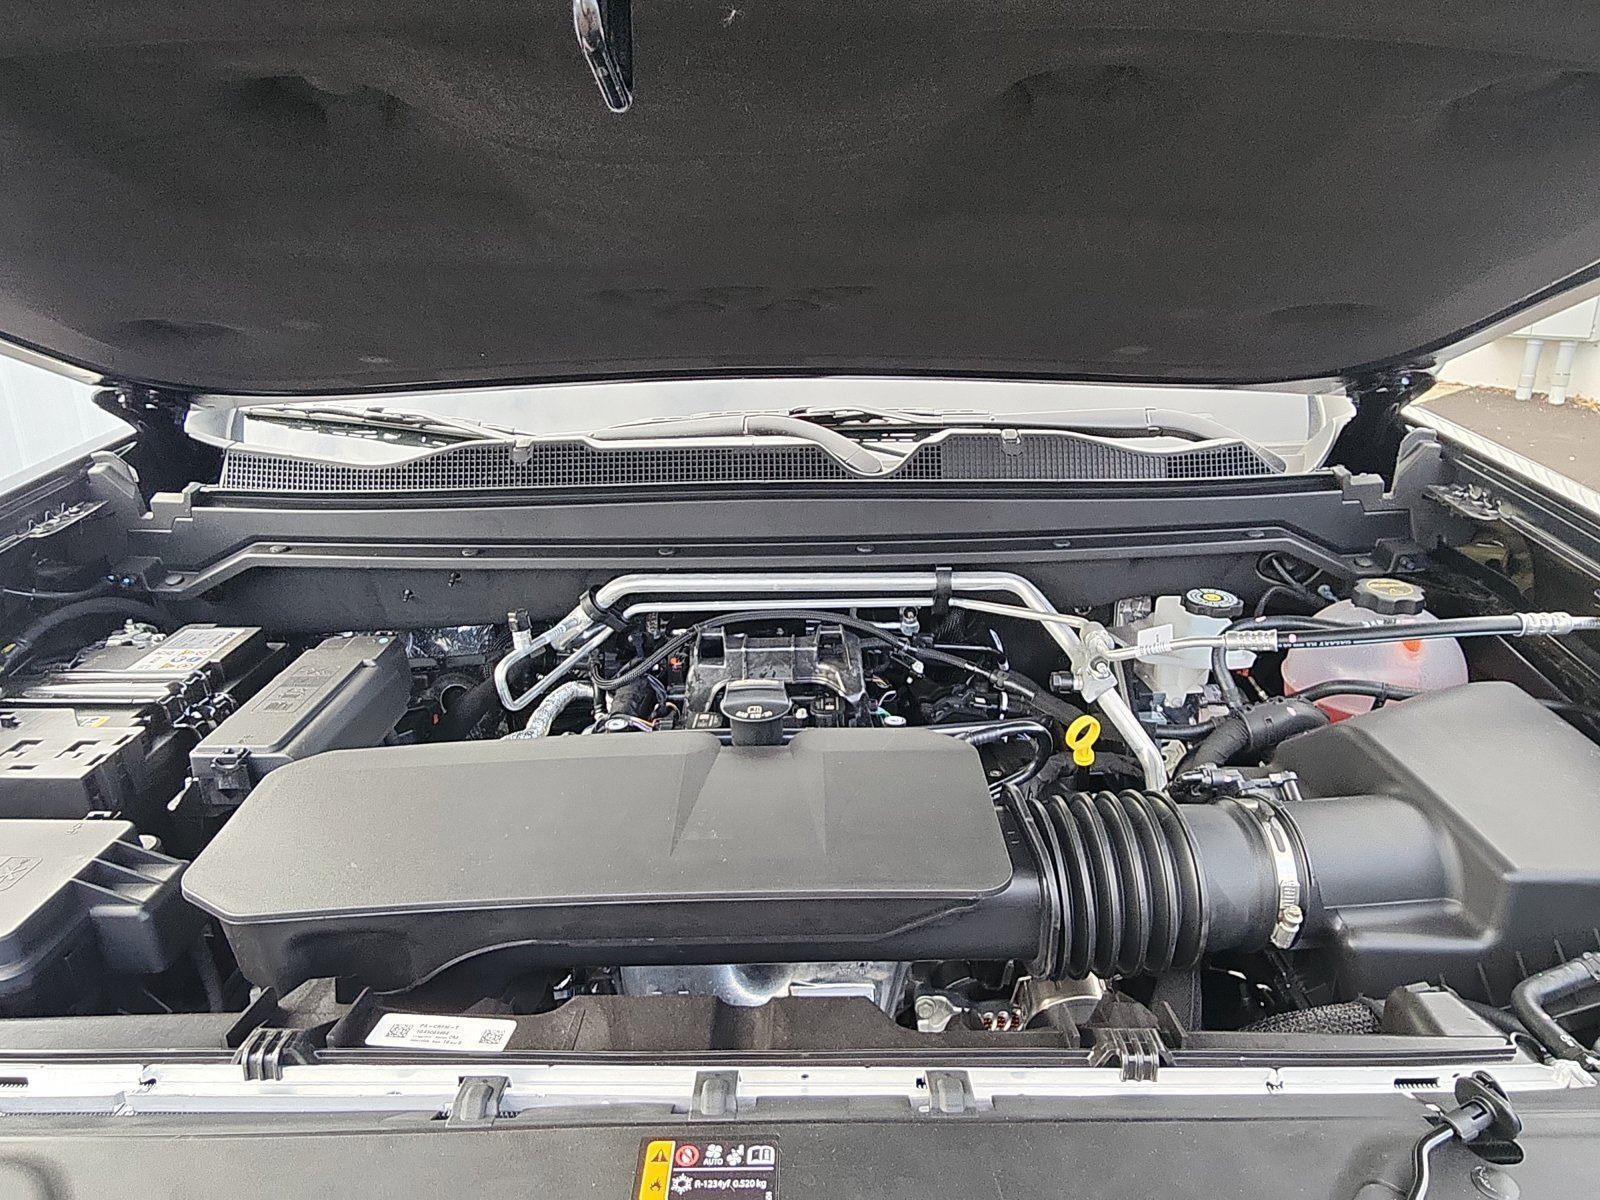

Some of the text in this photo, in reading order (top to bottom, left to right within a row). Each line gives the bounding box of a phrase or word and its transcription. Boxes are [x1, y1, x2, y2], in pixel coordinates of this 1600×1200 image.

[703, 1157, 724, 1166] AUTO
[694, 1178, 767, 1191] R-1234yf 0.520 kg
